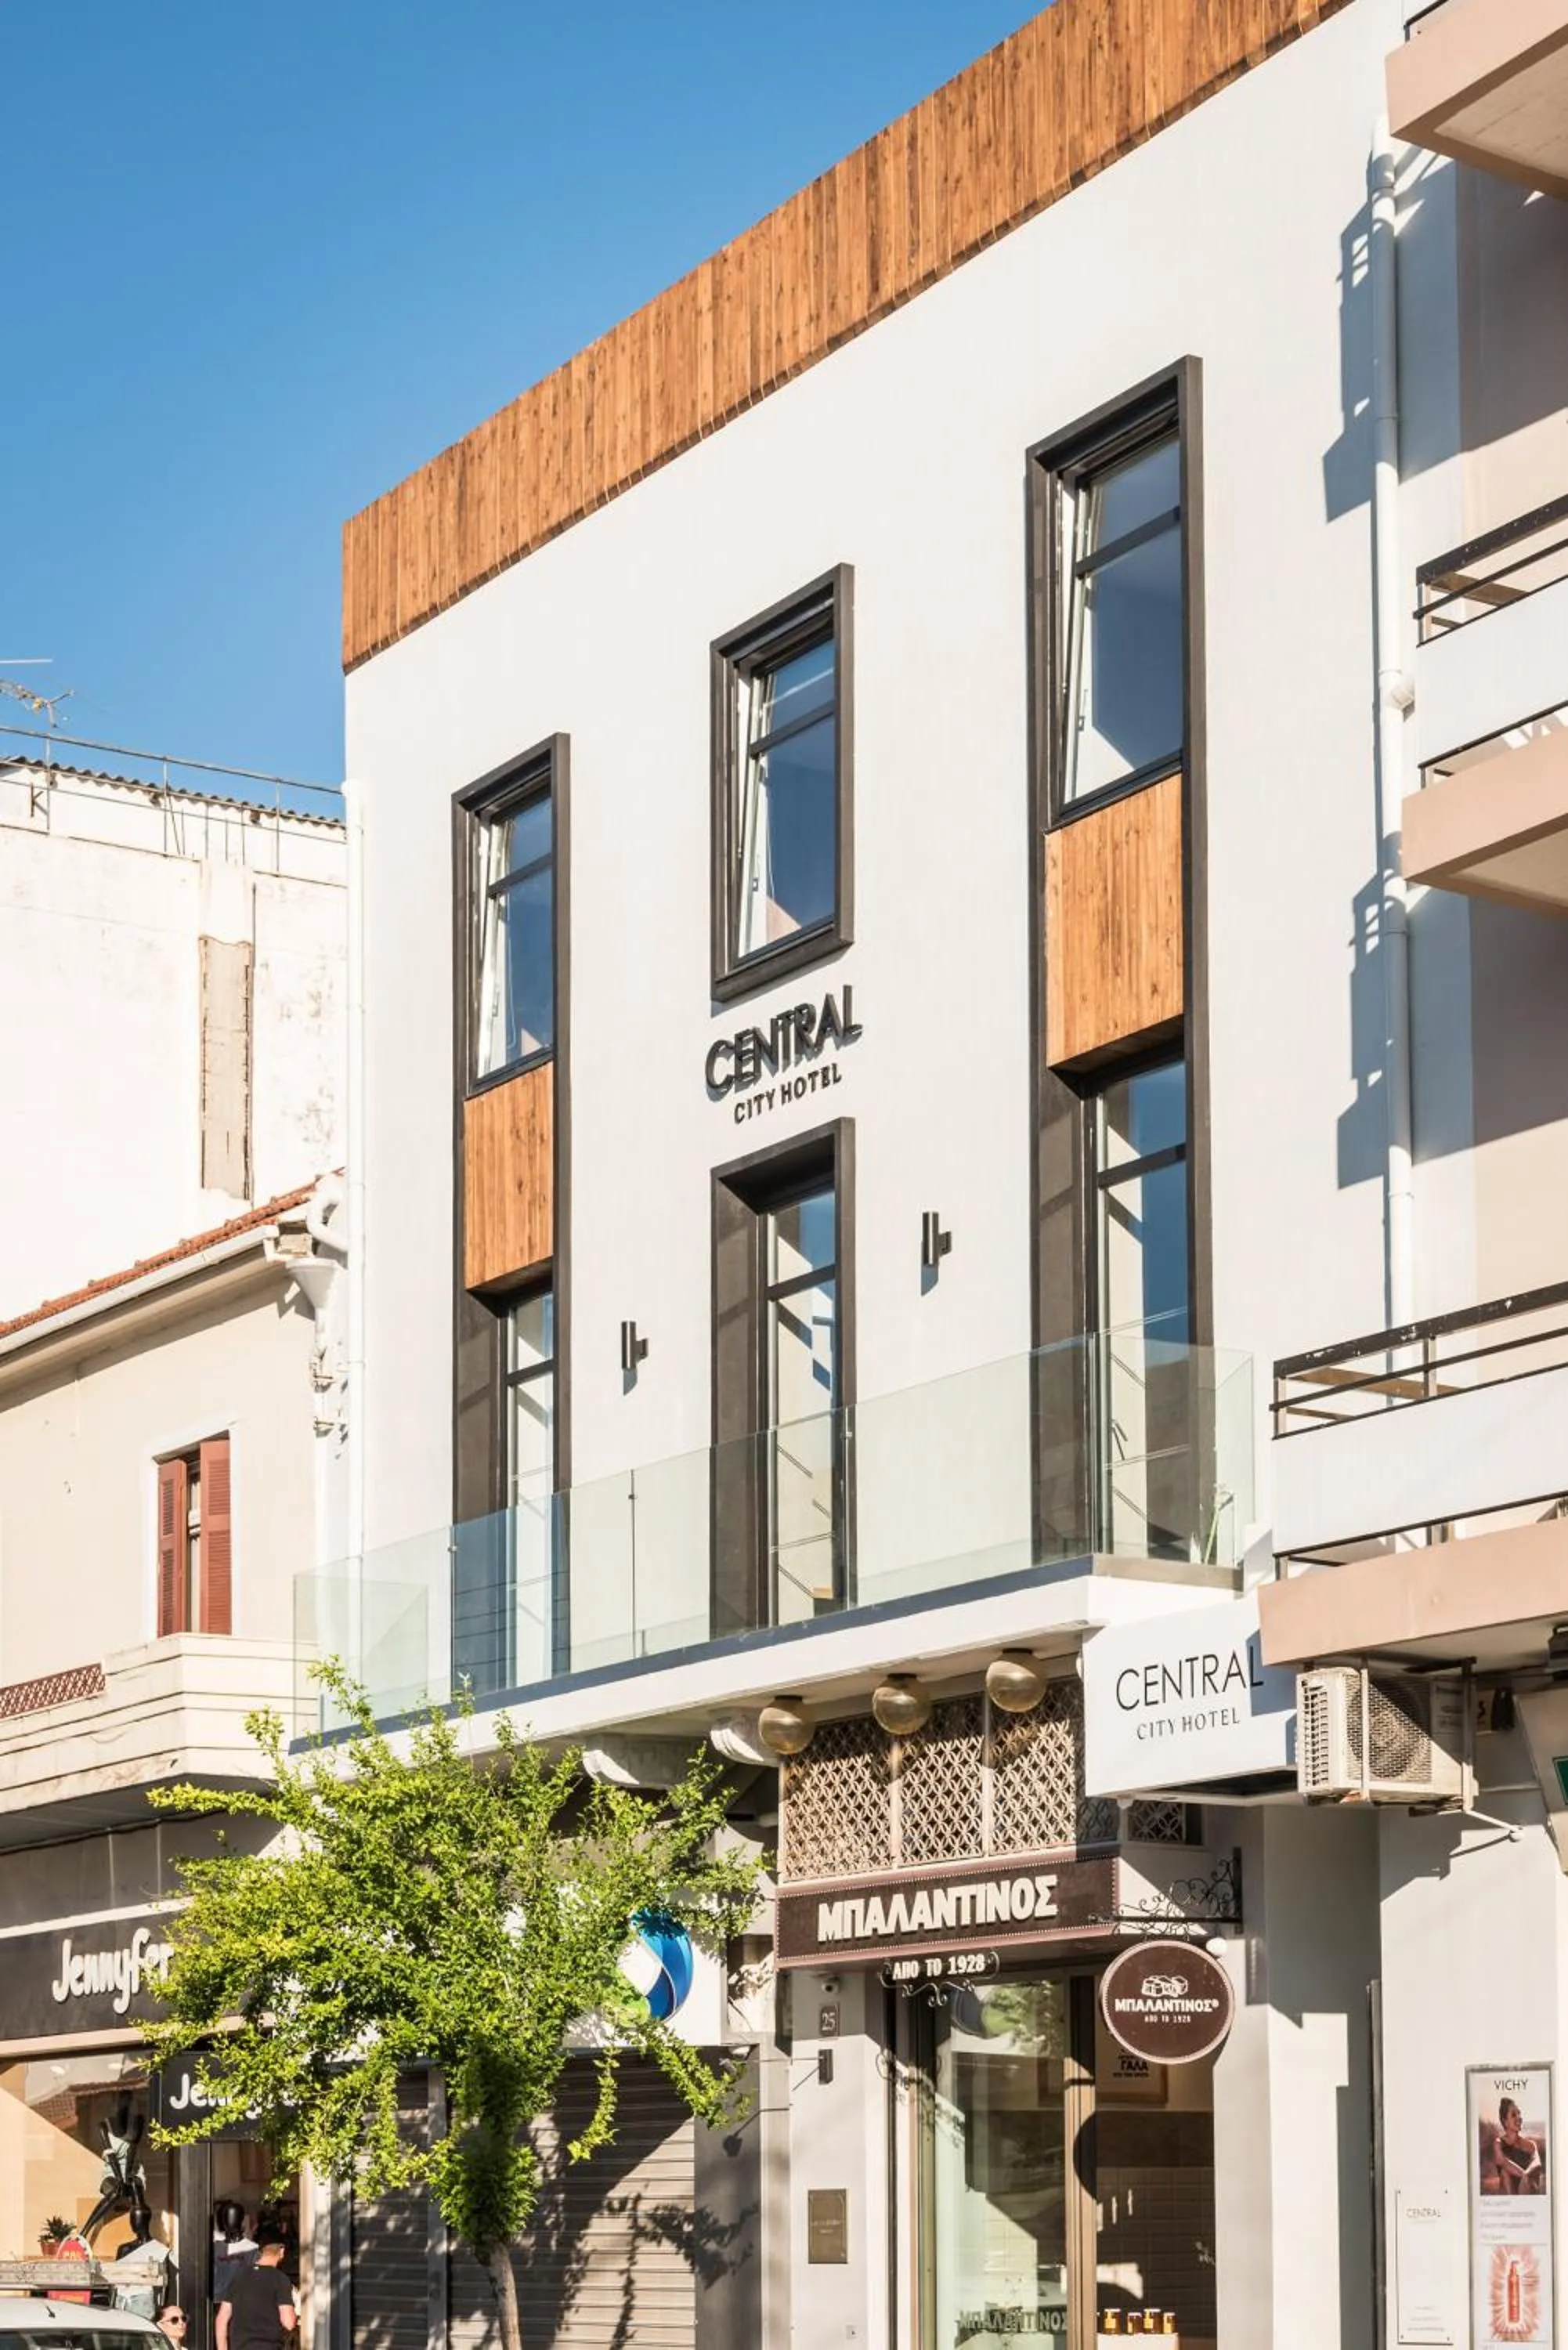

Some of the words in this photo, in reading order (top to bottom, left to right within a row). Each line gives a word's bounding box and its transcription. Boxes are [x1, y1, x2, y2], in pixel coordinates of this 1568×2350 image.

[706, 985, 863, 1094] CENTRAL
[734, 1088, 776, 1125] CITY
[781, 1062, 843, 1106] HOTEL
[1116, 1646, 1265, 1712] CENTRAL
[1136, 1718, 1176, 1740] CITY
[1182, 1707, 1241, 1733] HOTEL
[817, 1874, 1058, 1943] ΜΠΑΛΑΝΤΙΝΟΣ
[892, 1959, 919, 1980] ΑΠΟ
[925, 1958, 942, 1977] ΤΟ
[947, 1954, 986, 1975] 1928
[822, 2012, 836, 2031] 25
[1494, 2079, 1528, 2091] VICHY
